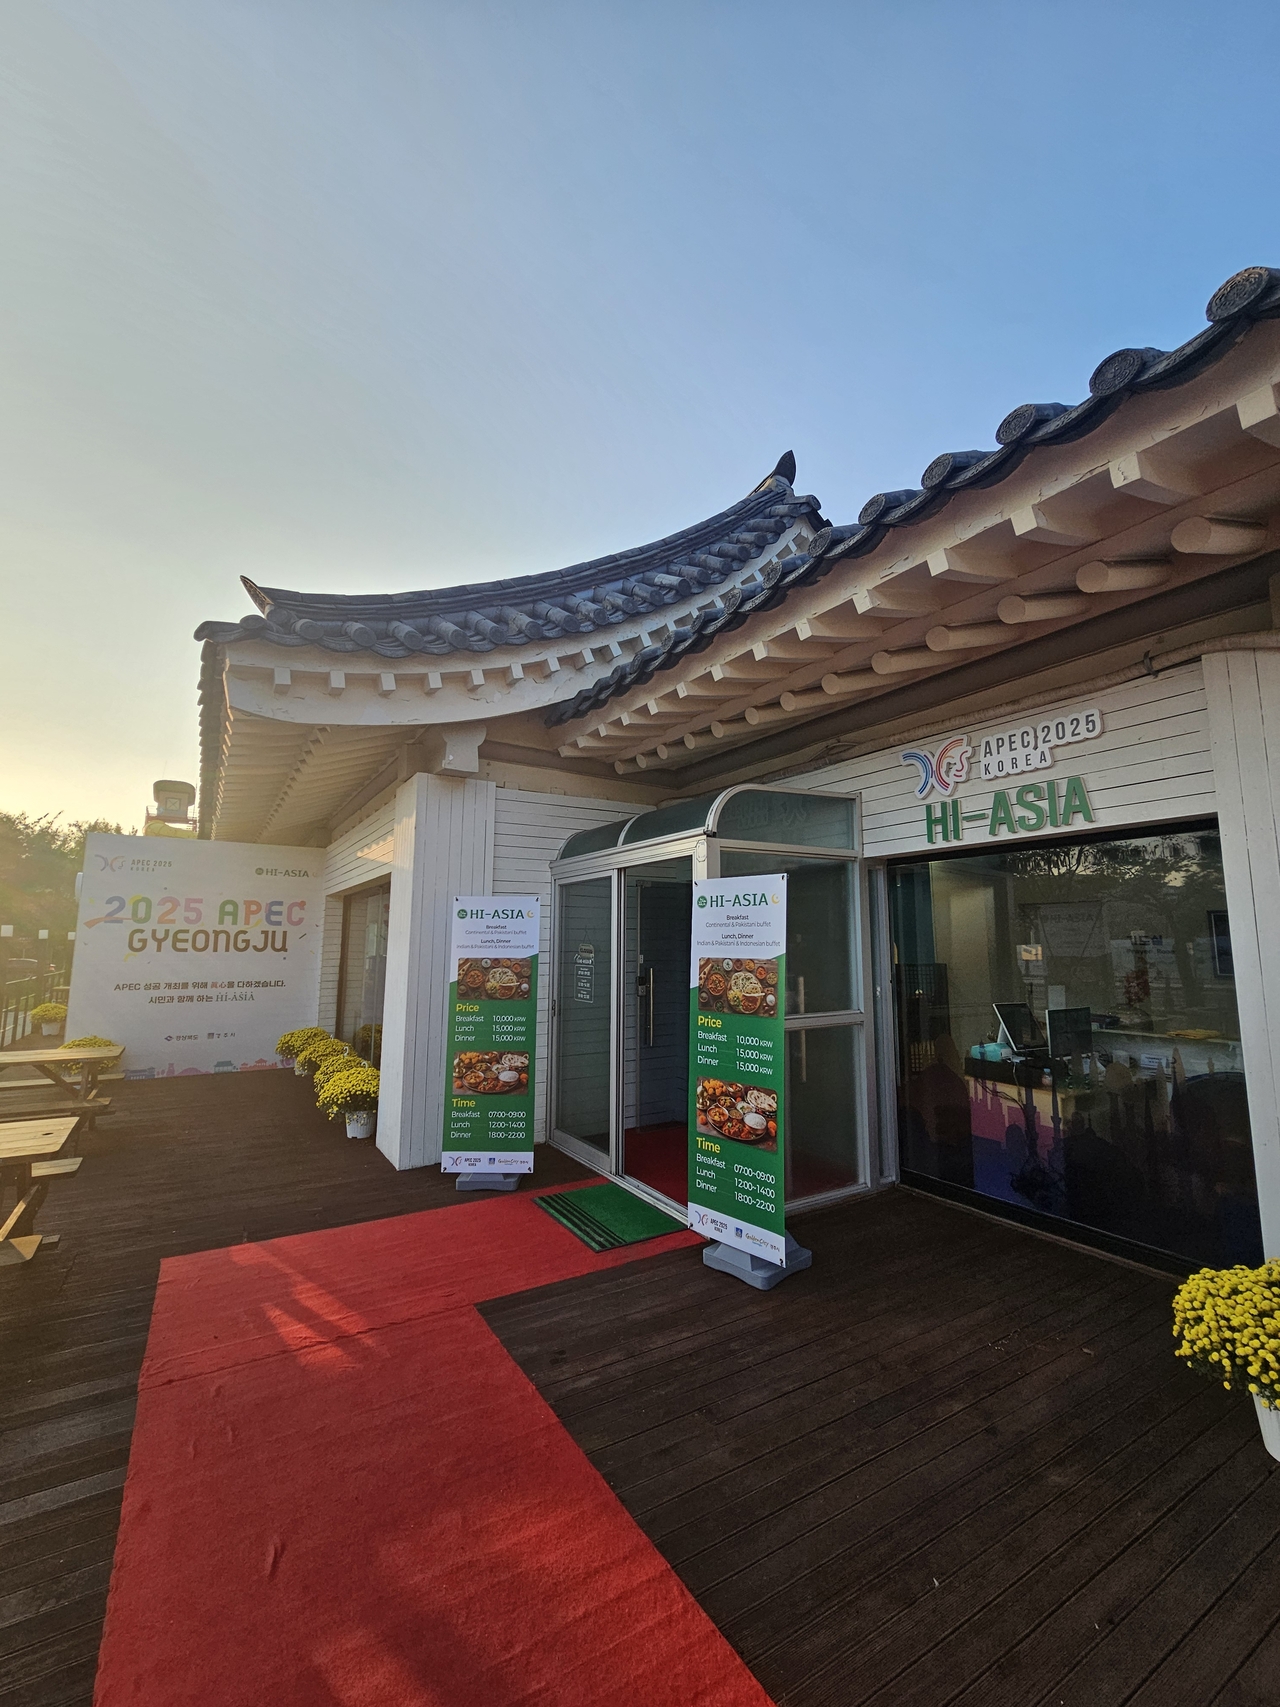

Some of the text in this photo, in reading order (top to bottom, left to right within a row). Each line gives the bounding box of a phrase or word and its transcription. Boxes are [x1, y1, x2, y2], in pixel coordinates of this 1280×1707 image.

[983, 713, 1096, 758] APEC 2025
[984, 751, 1047, 775] KOREA
[925, 776, 1096, 844] HI-ASIA
[131, 859, 173, 868] APEC 2025
[265, 868, 310, 878] HI-ASIA
[710, 893, 768, 908] HI-ASIA
[104, 895, 306, 926] 2025 APEC
[470, 909, 524, 920] HI-ASIA
[127, 928, 288, 953] GYEONGJU
[114, 983, 141, 991] APEC
[144, 982, 161, 991] 성공
[163, 982, 189, 990] 개최를
[192, 981, 208, 989] 위해
[237, 980, 286, 988] 다하겠습니다.
[148, 995, 175, 1004] 시민과
[177, 994, 194, 1003] 함께
[196, 994, 213, 1002] 하는
[456, 1003, 480, 1012] Price
[698, 1015, 722, 1028] Price
[492, 1034, 513, 1042] 15,000
[697, 1030, 773, 1048] Breakfast 10,000 KRW
[697, 1043, 773, 1061] Lunch 15,000 KRW
[697, 1056, 773, 1075] Dinner 15,000 KRW
[451, 1098, 476, 1107] Time
[696, 1137, 720, 1153] Time
[696, 1153, 775, 1184] Breakfast 07:00-09:00
[696, 1166, 775, 1198] Lunch 12:00-14:00
[696, 1179, 775, 1213] Dinner 18:00-22:00
